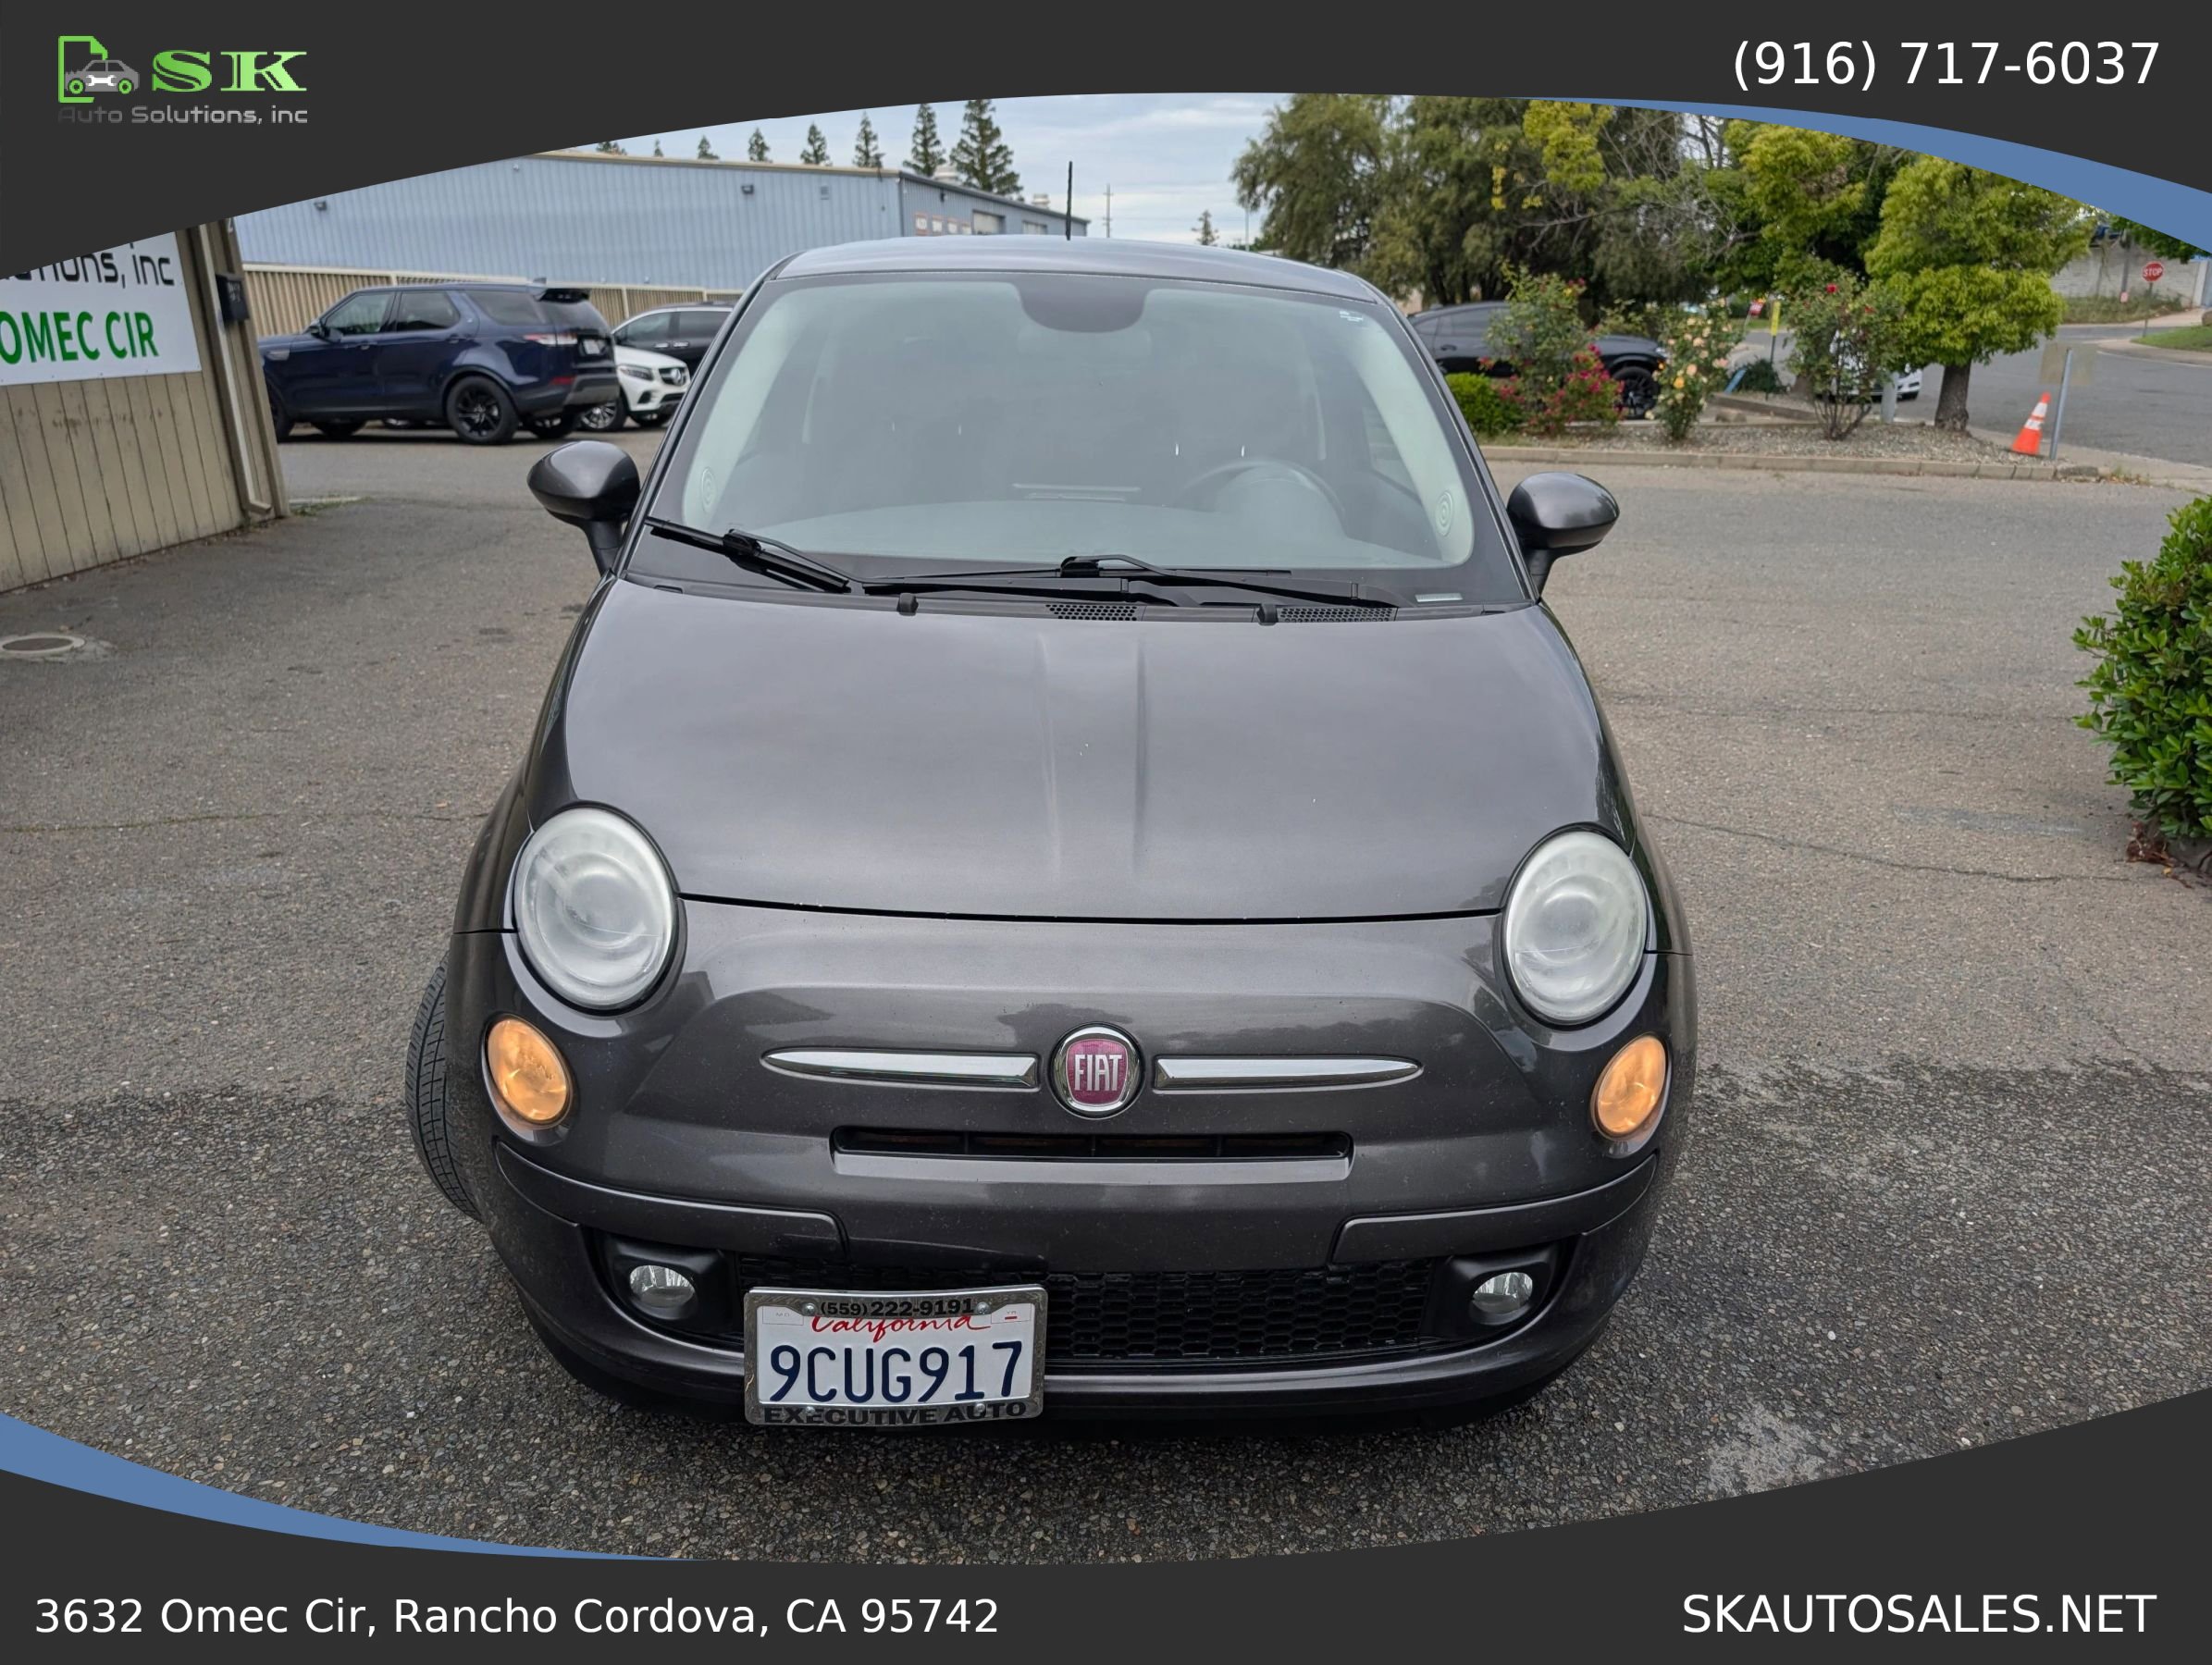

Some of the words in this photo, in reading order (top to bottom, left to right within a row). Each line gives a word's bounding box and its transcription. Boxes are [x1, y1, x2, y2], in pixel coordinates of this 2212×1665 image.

[130, 242, 175, 286] inc
[0, 311, 101, 364] OMEC
[105, 311, 159, 360] CIR
[1074, 1054, 1123, 1092] FIAT
[821, 1301, 868, 1316] (559)
[870, 1298, 975, 1317] 222-9191
[811, 1315, 992, 1344] California
[769, 1340, 1023, 1404] 9CUG917
[763, 1406, 937, 1425] EXECUTIVE
[943, 1400, 1027, 1423] AUTO
